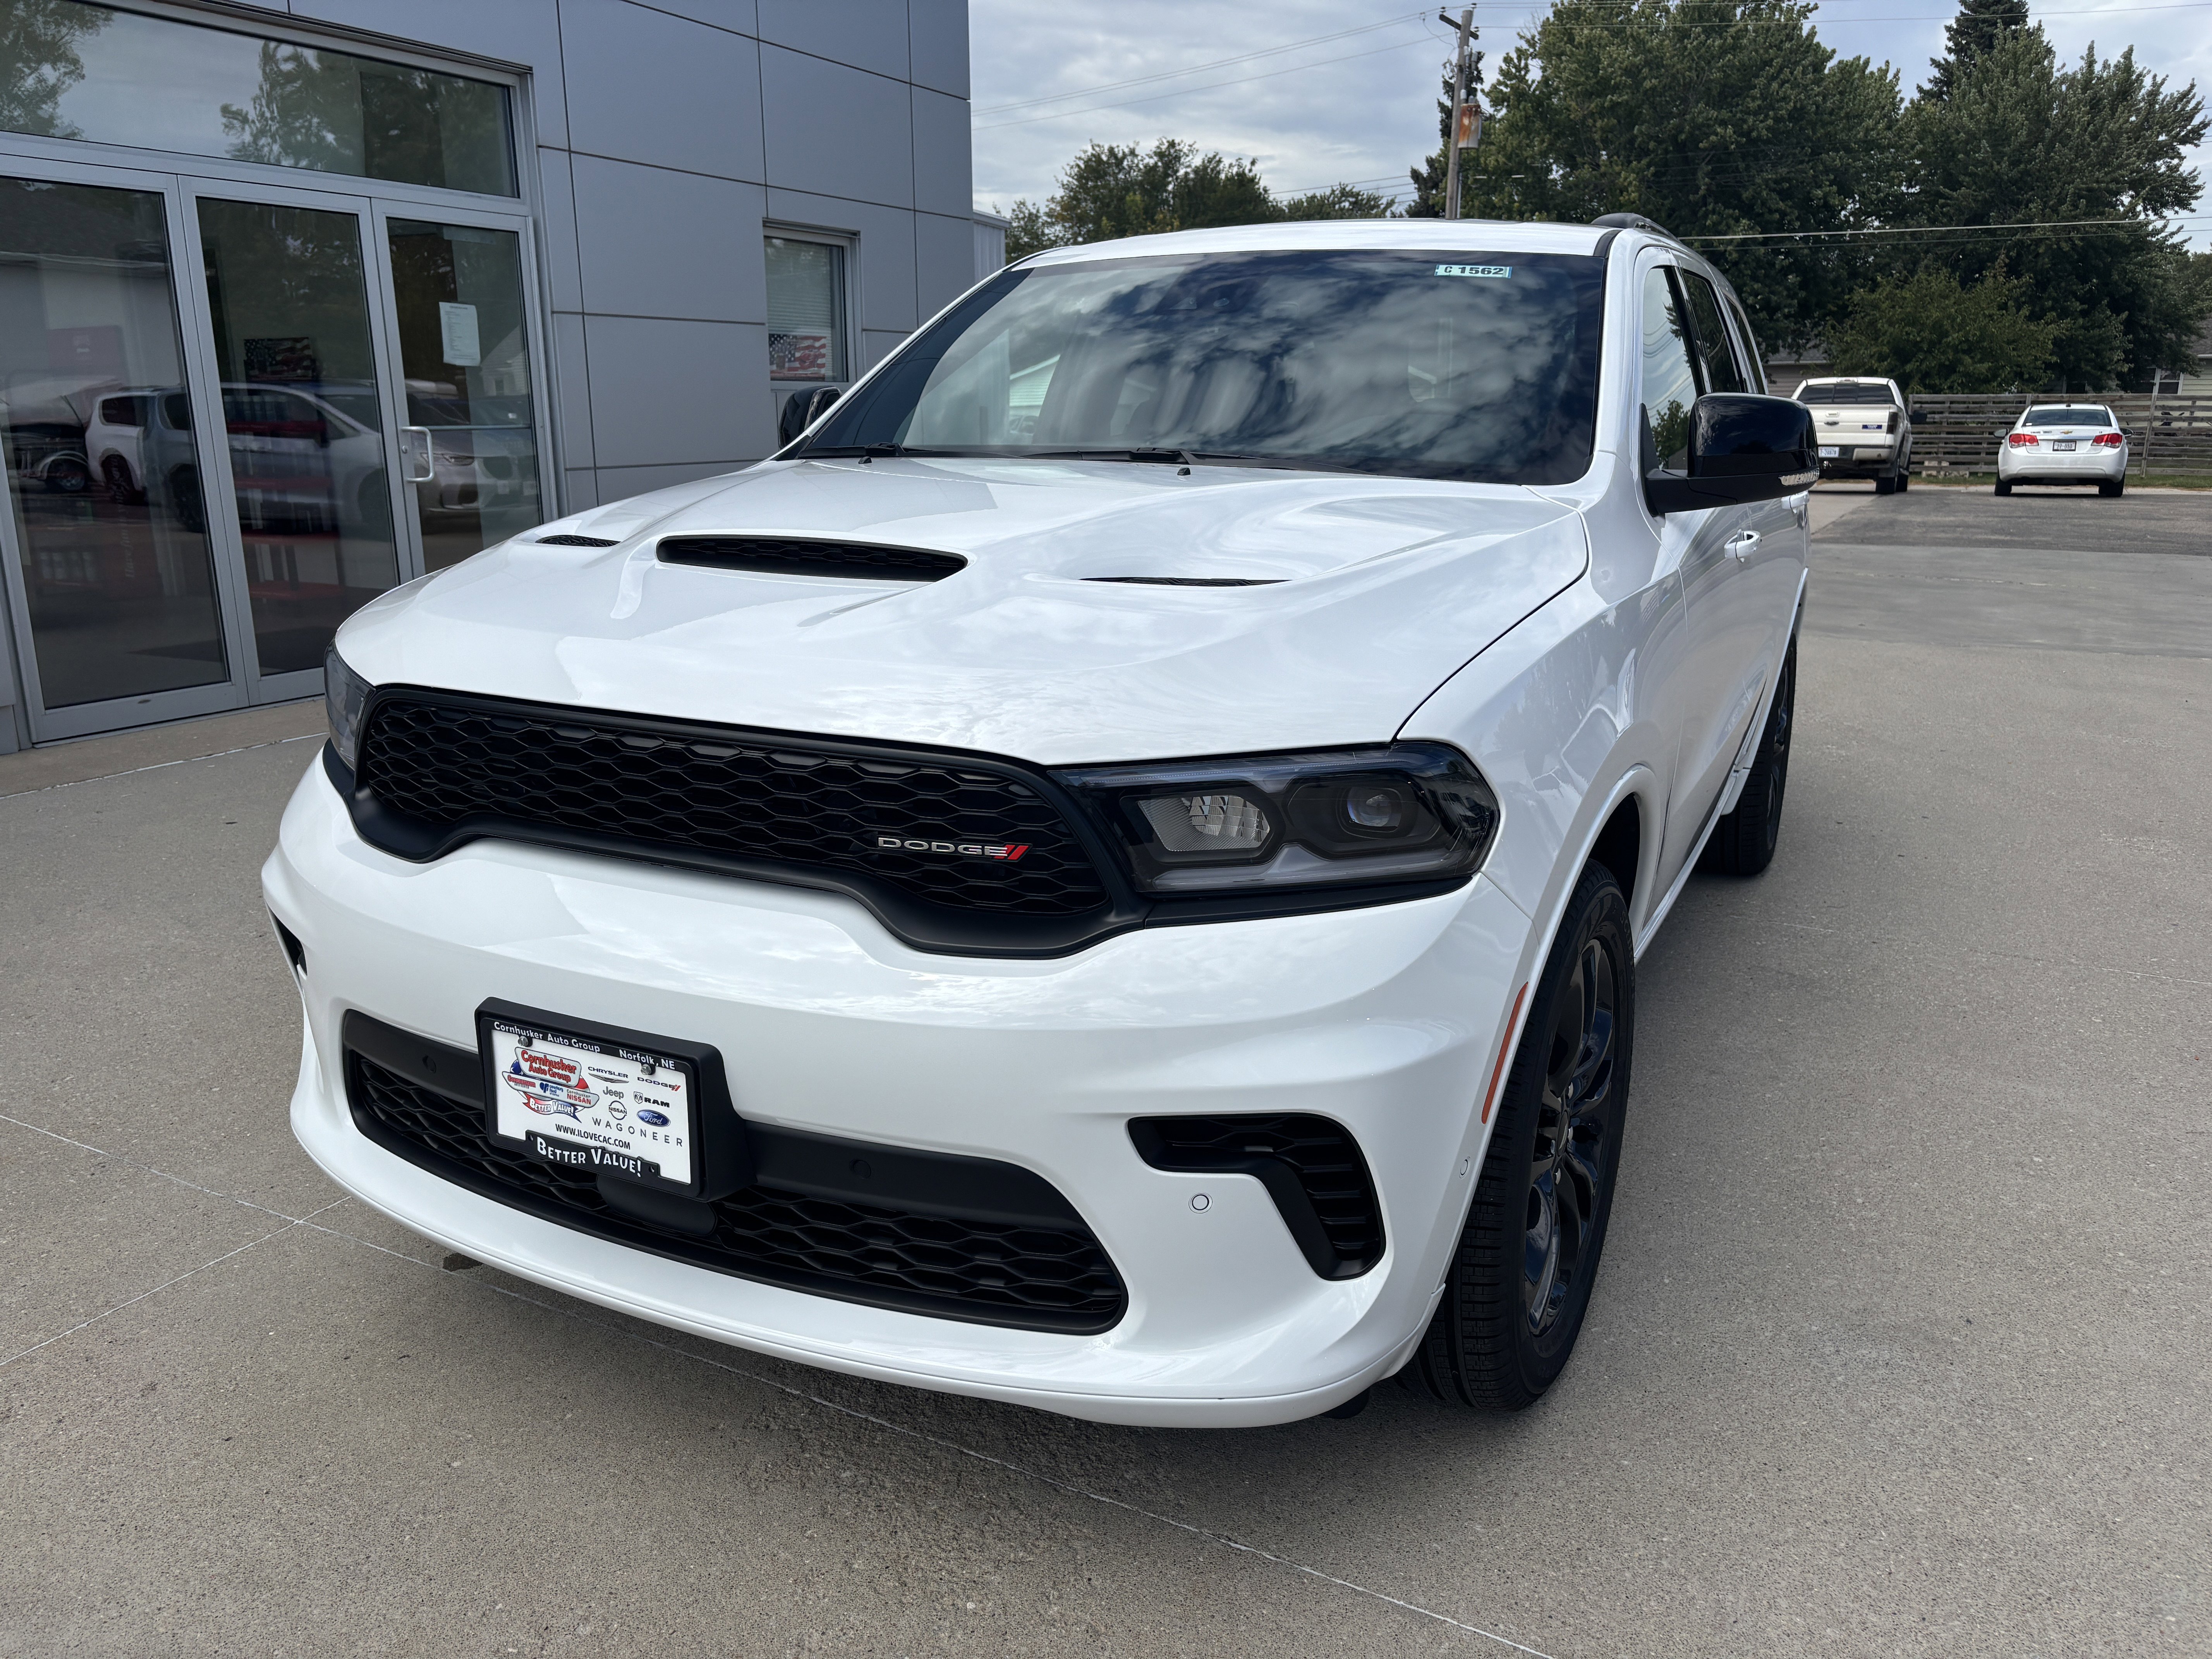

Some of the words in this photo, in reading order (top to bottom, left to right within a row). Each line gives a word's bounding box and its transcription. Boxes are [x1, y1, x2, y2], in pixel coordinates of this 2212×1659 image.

[1458, 266, 1504, 275] 1562
[878, 837, 1008, 856] DODGE
[494, 1022, 543, 1039] Cornhusker
[548, 1034, 569, 1045] Auto
[572, 1039, 600, 1053] Group
[661, 1058, 675, 1070] NE
[521, 1050, 577, 1074] Cornhusker
[529, 1063, 547, 1075] Auto
[548, 1069, 571, 1083] Group
[588, 1066, 628, 1079] CHRYSLER
[637, 1077, 676, 1089] DODGE
[567, 1089, 591, 1098] Cornhusker
[567, 1093, 591, 1105] NISSAN
[603, 1086, 624, 1099] Jeep
[644, 1097, 670, 1108] RAM
[609, 1106, 627, 1115] NISSAN
[644, 1111, 663, 1125] Ford
[555, 1124, 630, 1150] WWW.ILOVECAC.COM
[592, 1117, 682, 1147] WAGONEER
